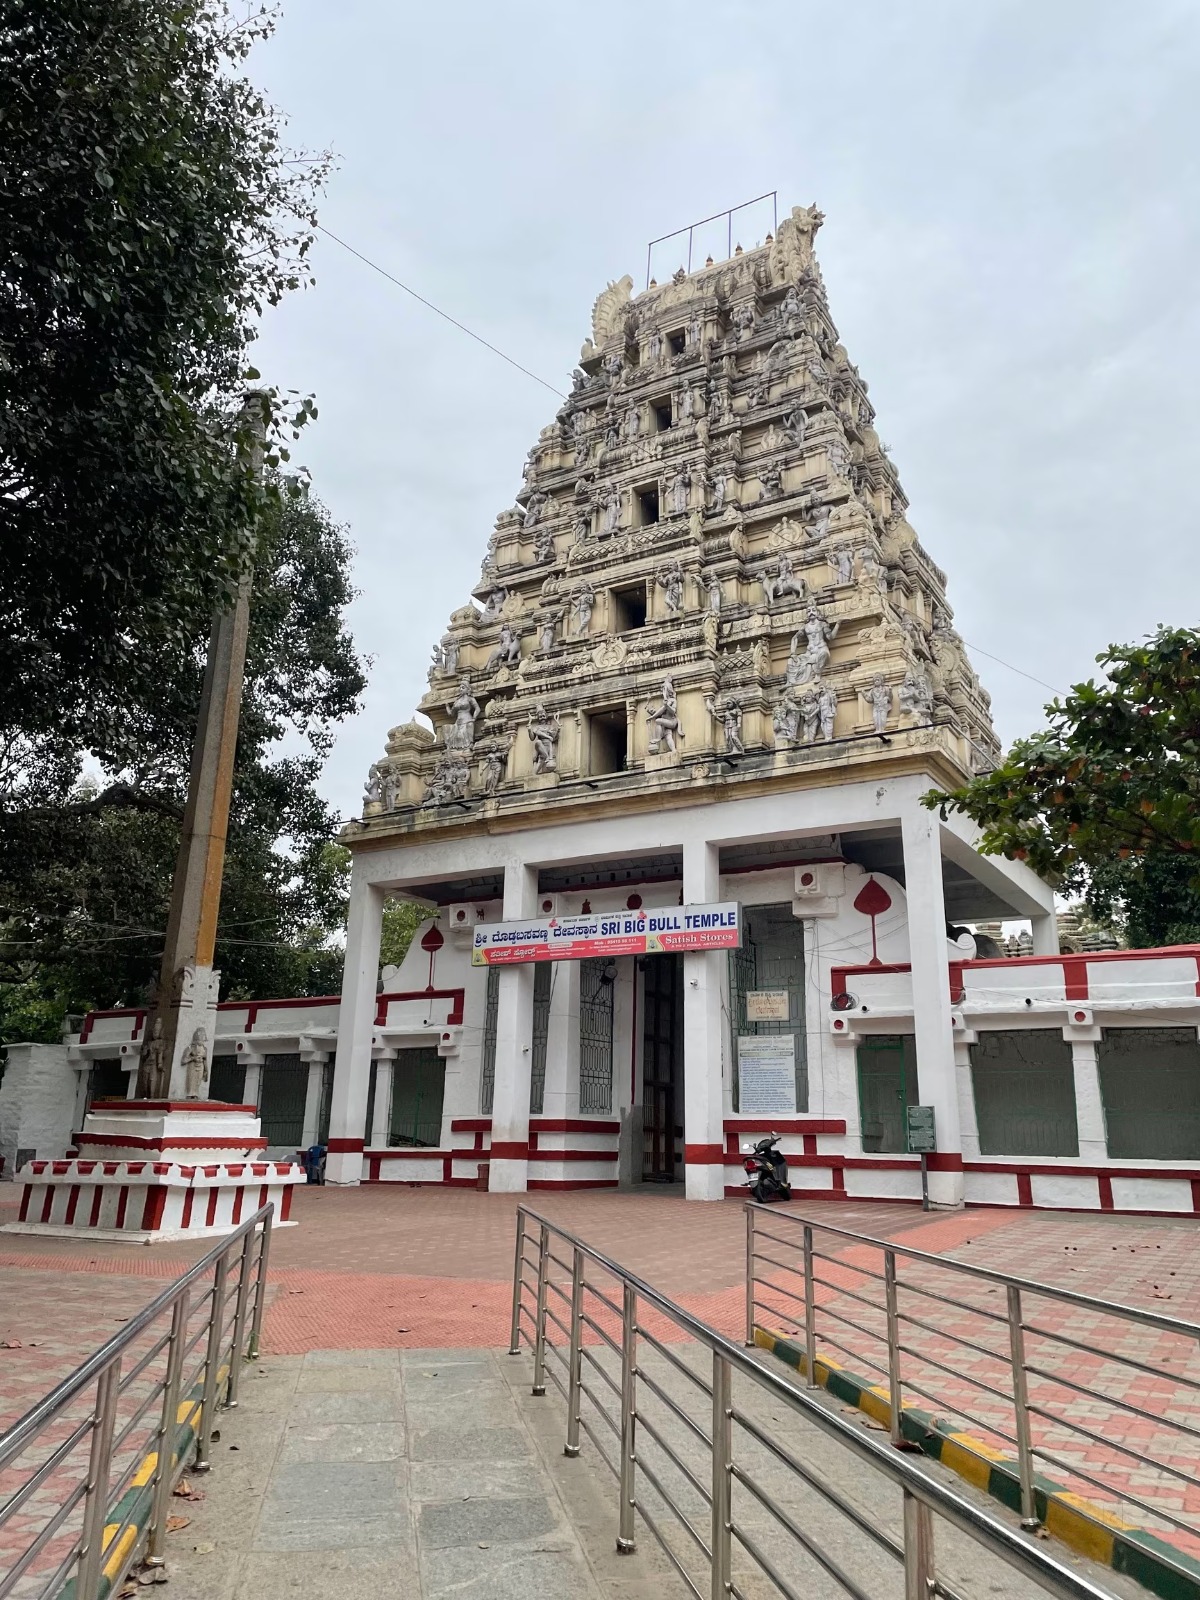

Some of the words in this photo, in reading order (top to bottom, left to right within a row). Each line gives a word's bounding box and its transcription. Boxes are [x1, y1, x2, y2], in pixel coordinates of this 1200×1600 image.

[475, 932, 488, 947] ಶ್ರೀ
[492, 928, 549, 944] ದೊಡ್ಡಬಸವಣ್ಣ
[553, 923, 598, 939] ದೇವಸ್ಥಾನ
[601, 921, 620, 935] SRI
[624, 919, 645, 934] BIG
[649, 917, 681, 932] BULL
[685, 912, 736, 929] TEMPLE
[665, 934, 697, 944] Satish
[700, 932, 733, 942] Stores
